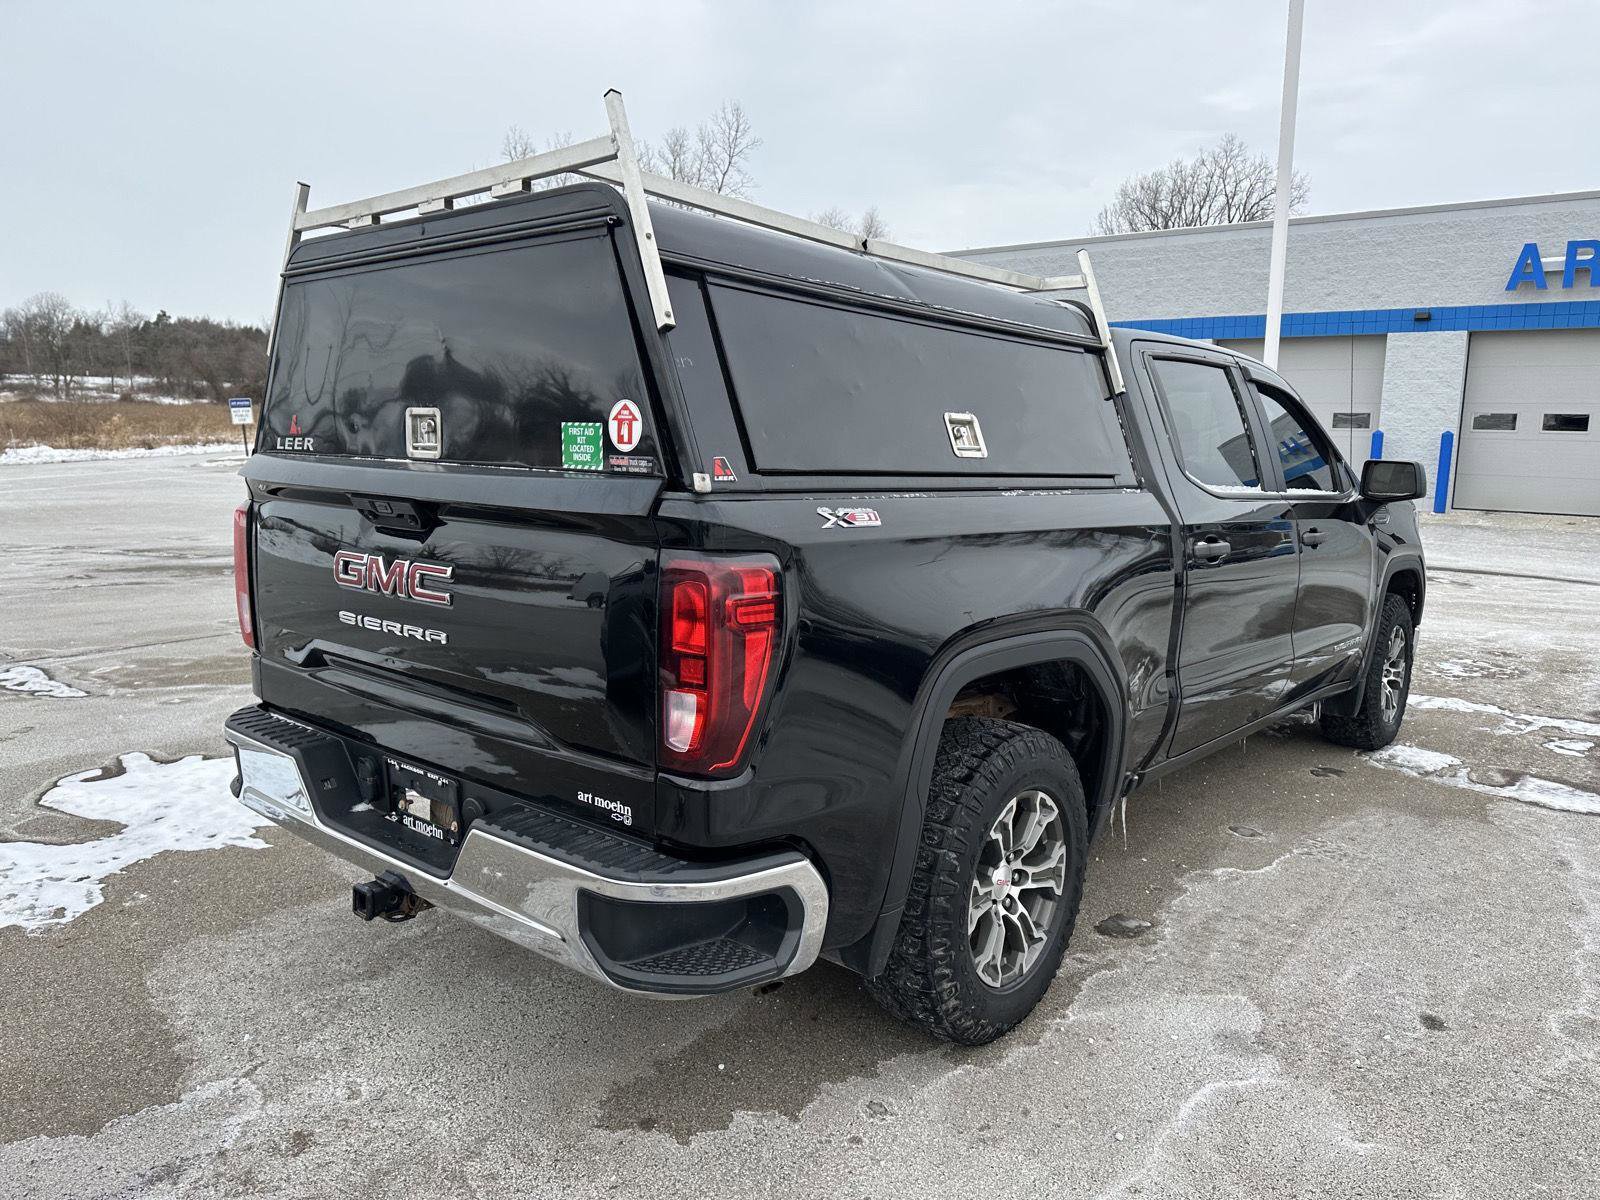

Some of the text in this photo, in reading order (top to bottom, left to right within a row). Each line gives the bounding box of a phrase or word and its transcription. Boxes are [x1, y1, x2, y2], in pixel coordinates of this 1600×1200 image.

[1504, 239, 1600, 292] AR
[568, 427, 595, 436] FIRST AID
[576, 436, 586, 444] KIT
[276, 436, 314, 451] LEER
[569, 444, 595, 453] LOCATED
[572, 453, 592, 462] INSIDE
[334, 550, 453, 606] GMC
[338, 610, 449, 645] SIERRA
[577, 791, 632, 817] art moehn
[402, 814, 444, 840] art moehn
